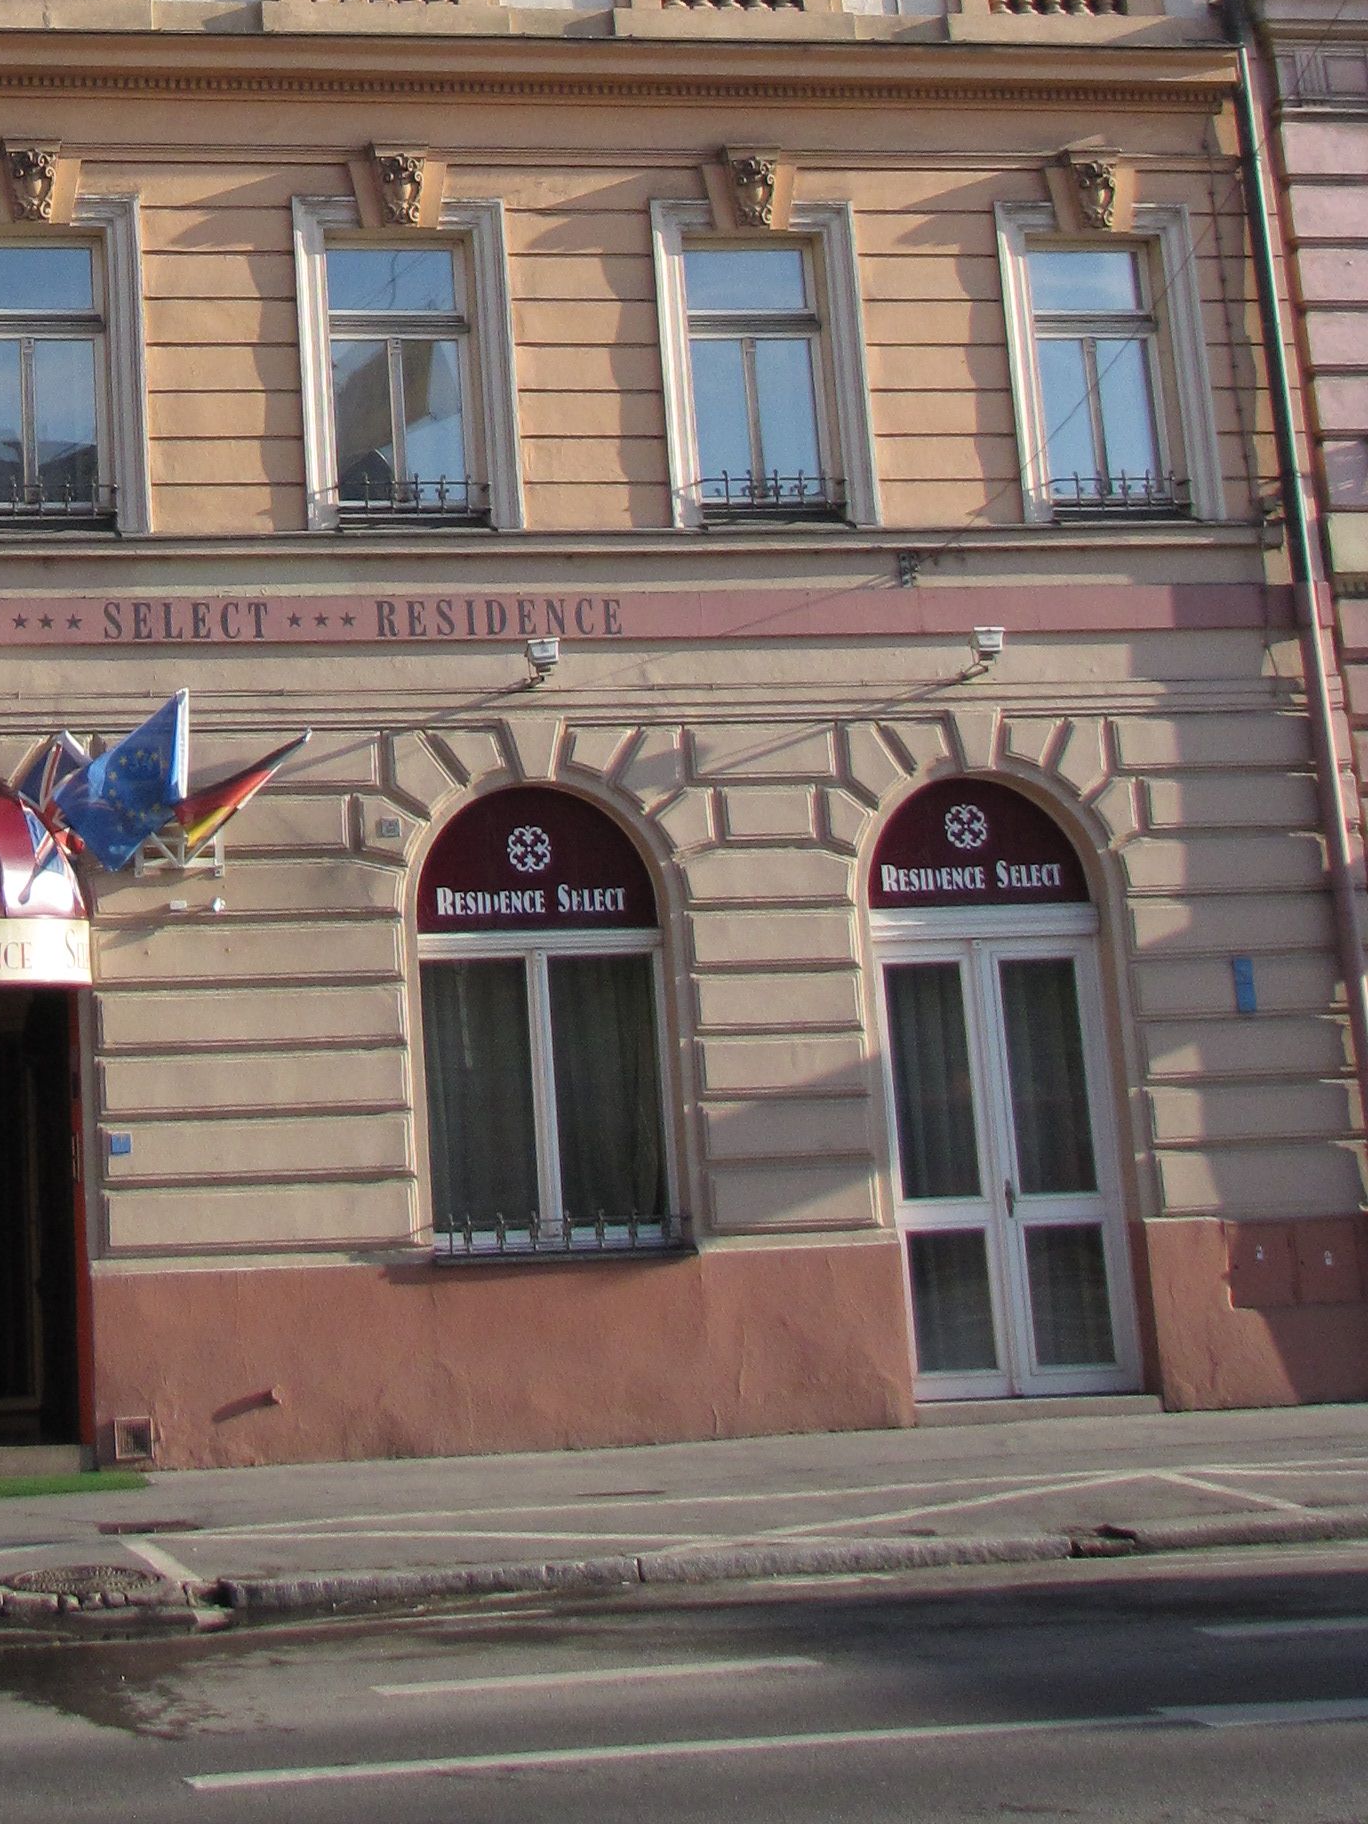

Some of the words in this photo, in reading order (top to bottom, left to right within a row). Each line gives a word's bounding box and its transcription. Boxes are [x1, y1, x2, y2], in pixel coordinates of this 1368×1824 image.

[103, 601, 269, 640] SELECT
[374, 598, 624, 638] RESIDENCE
[880, 864, 986, 892] RESIDENCE
[995, 859, 1062, 888] SELECT
[436, 886, 546, 915] RESIDENCE
[557, 884, 626, 913] SELECT
